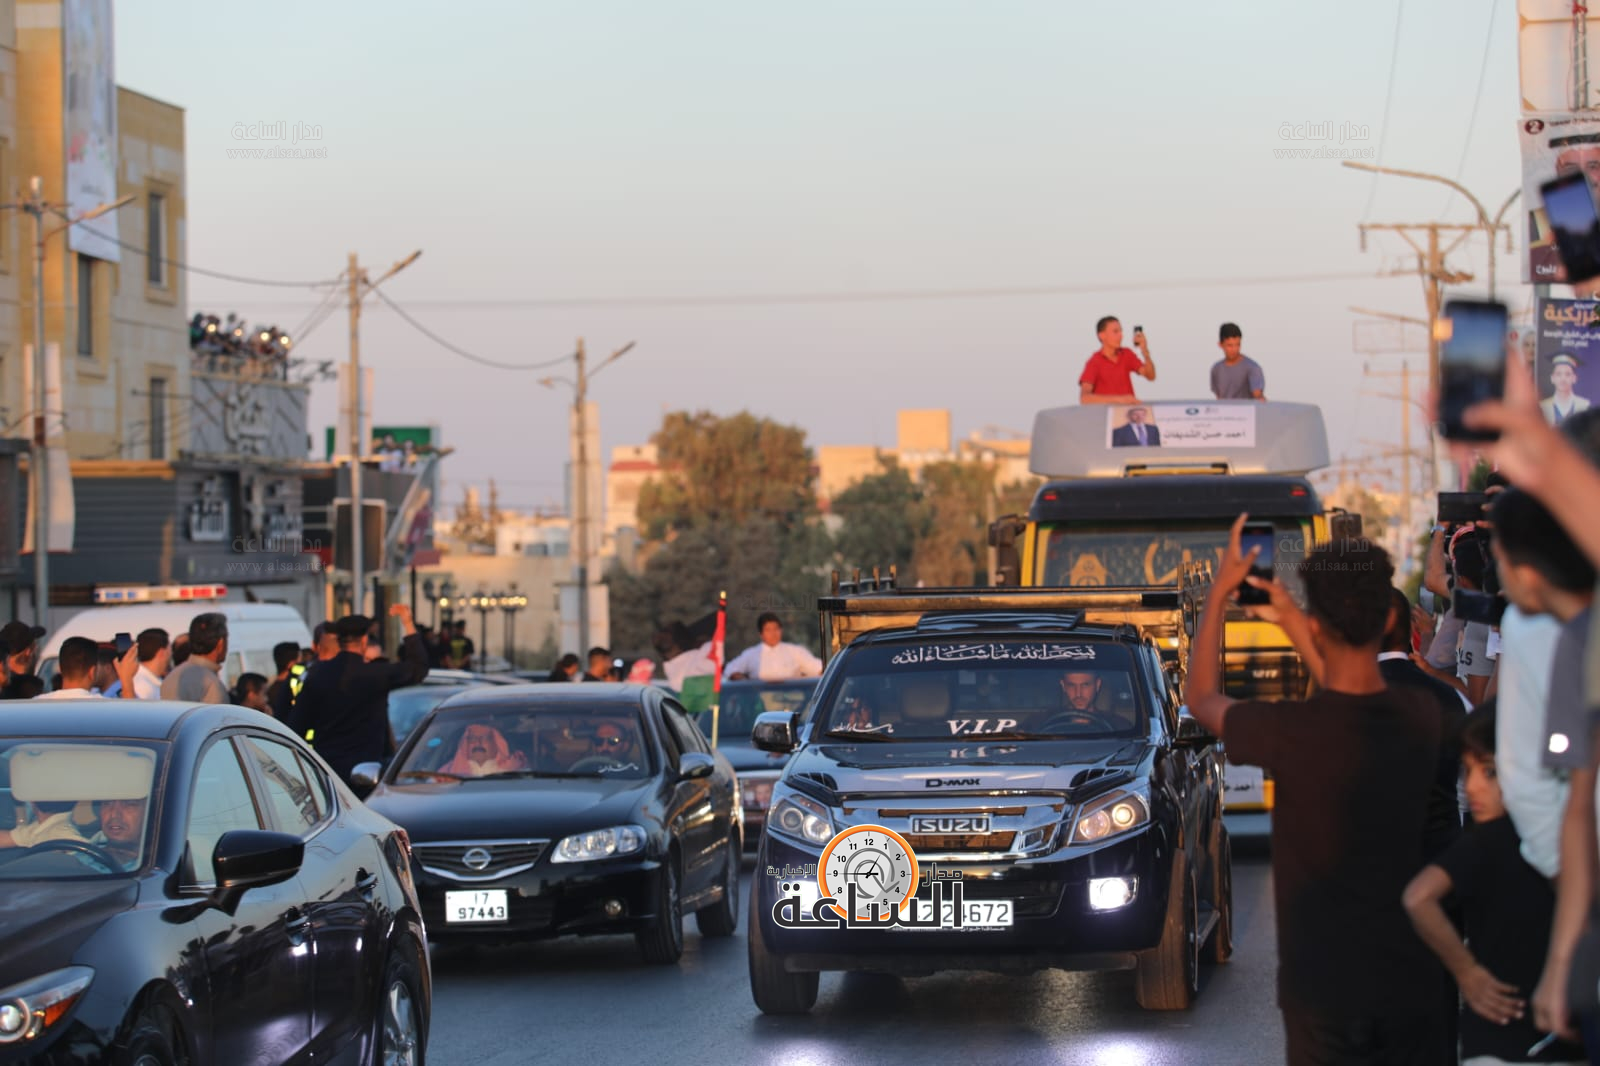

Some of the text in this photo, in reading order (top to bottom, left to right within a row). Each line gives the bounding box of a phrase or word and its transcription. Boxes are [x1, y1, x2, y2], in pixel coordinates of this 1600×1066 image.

[1455, 648, 1473, 666] LS
[947, 718, 1017, 735] V.I.P
[914, 818, 987, 833] ISUZU
[474, 892, 489, 904] 17
[458, 906, 505, 920] 97443
